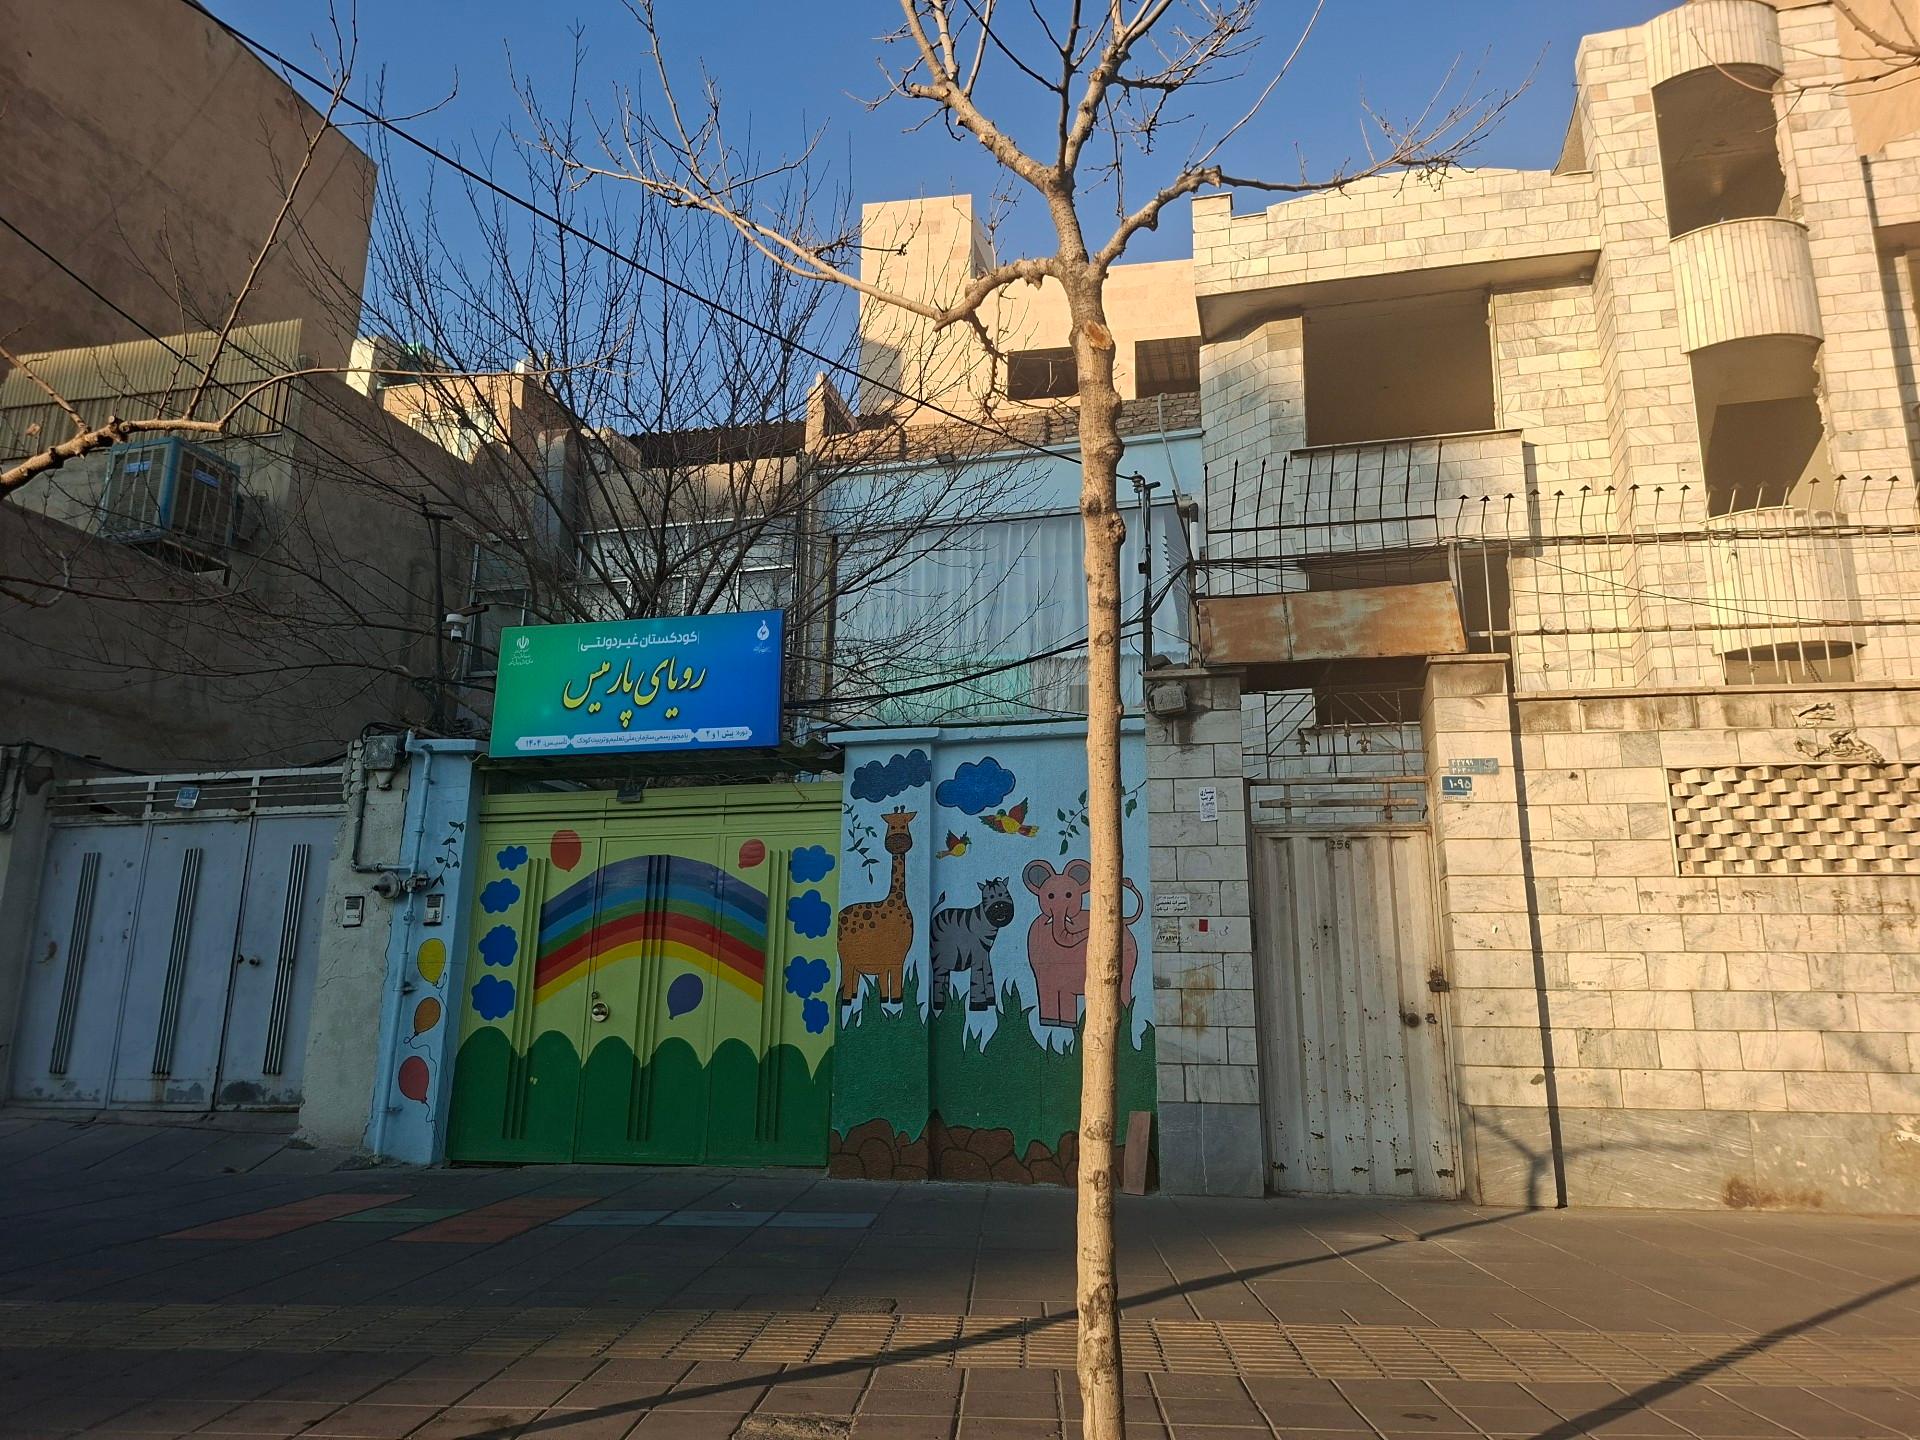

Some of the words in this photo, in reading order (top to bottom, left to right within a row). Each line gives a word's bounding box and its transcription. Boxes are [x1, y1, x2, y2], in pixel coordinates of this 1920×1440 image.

[580, 633, 639, 651] غیردولتی
[640, 631, 698, 647] کودکستان
[563, 658, 634, 728] پارمیس
[634, 655, 706, 719] رویای
[721, 730, 734, 739] پیش
[1449, 778, 1471, 789] ۱۰۹۵
[1330, 839, 1350, 849] 256
